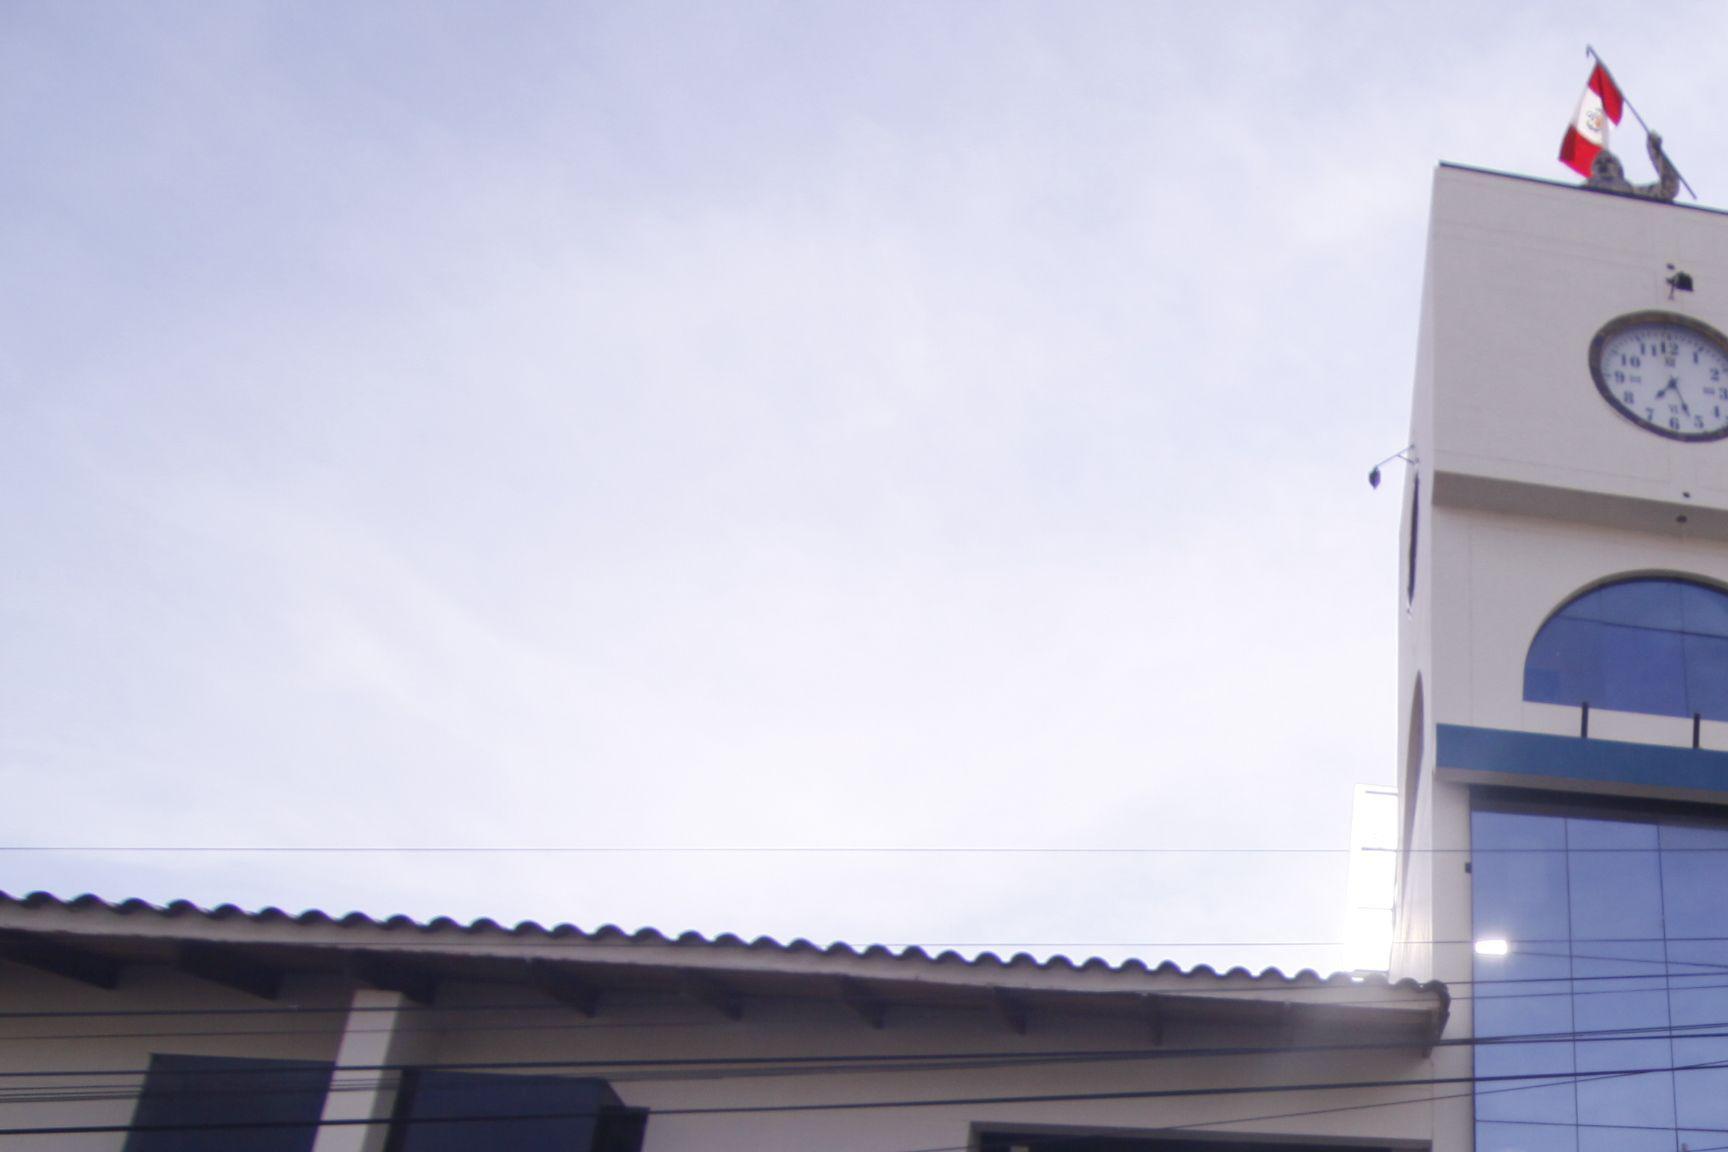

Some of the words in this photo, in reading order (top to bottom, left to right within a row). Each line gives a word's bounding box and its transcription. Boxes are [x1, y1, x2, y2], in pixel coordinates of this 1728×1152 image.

[1621, 353, 1641, 368] 10
[1614, 371, 1625, 384] 9
[1709, 368, 1720, 381] 2
[1719, 387, 1728, 400] 3
[1646, 407, 1654, 421] 7
[1669, 417, 1680, 430] 6
